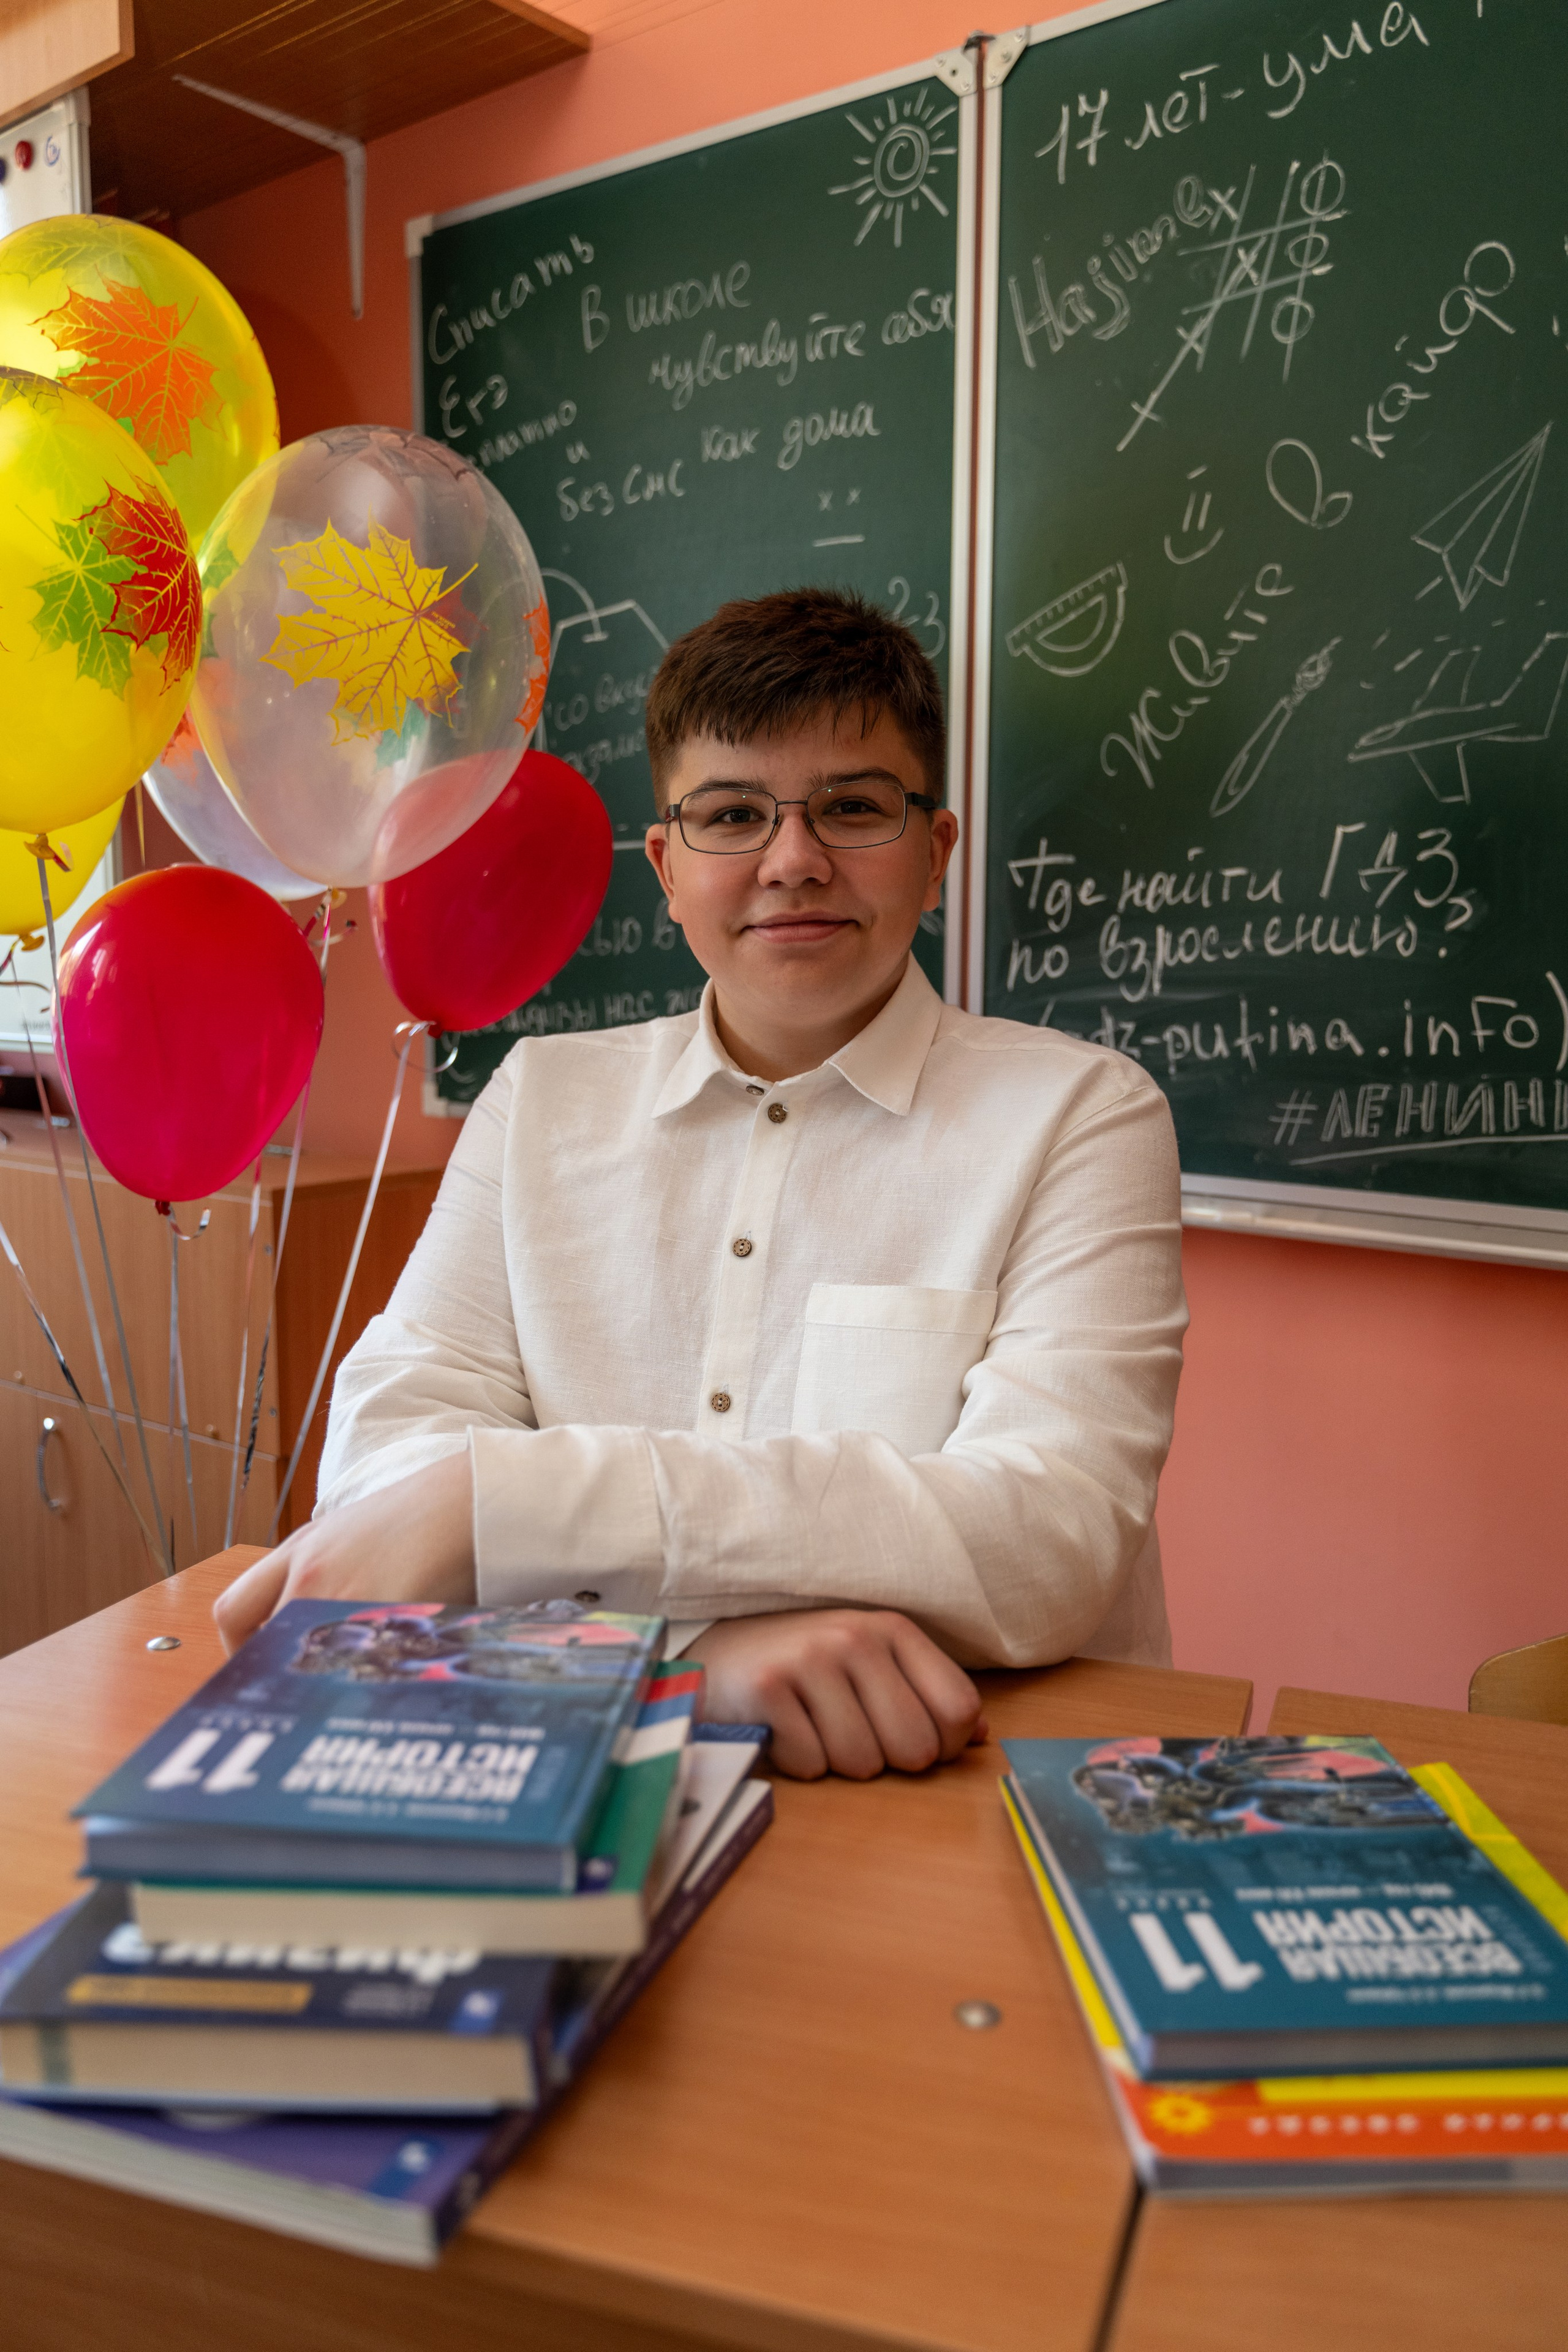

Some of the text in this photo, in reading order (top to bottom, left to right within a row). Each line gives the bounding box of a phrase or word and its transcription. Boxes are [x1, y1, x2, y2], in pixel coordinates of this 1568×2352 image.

[1035, 88, 1109, 184] 17
[429, 233, 595, 364] Списать
[626, 260, 752, 333] школе
[648, 311, 867, 411] чувствуйте
[700, 401, 882, 471] как дома
[1117, 846, 1284, 914] найти
[1008, 937, 1071, 993] по
[146, 1728, 276, 1794] 11
[1130, 1912, 1264, 1991] 11
[1253, 1904, 1494, 1947] ИСТОРИЯ
